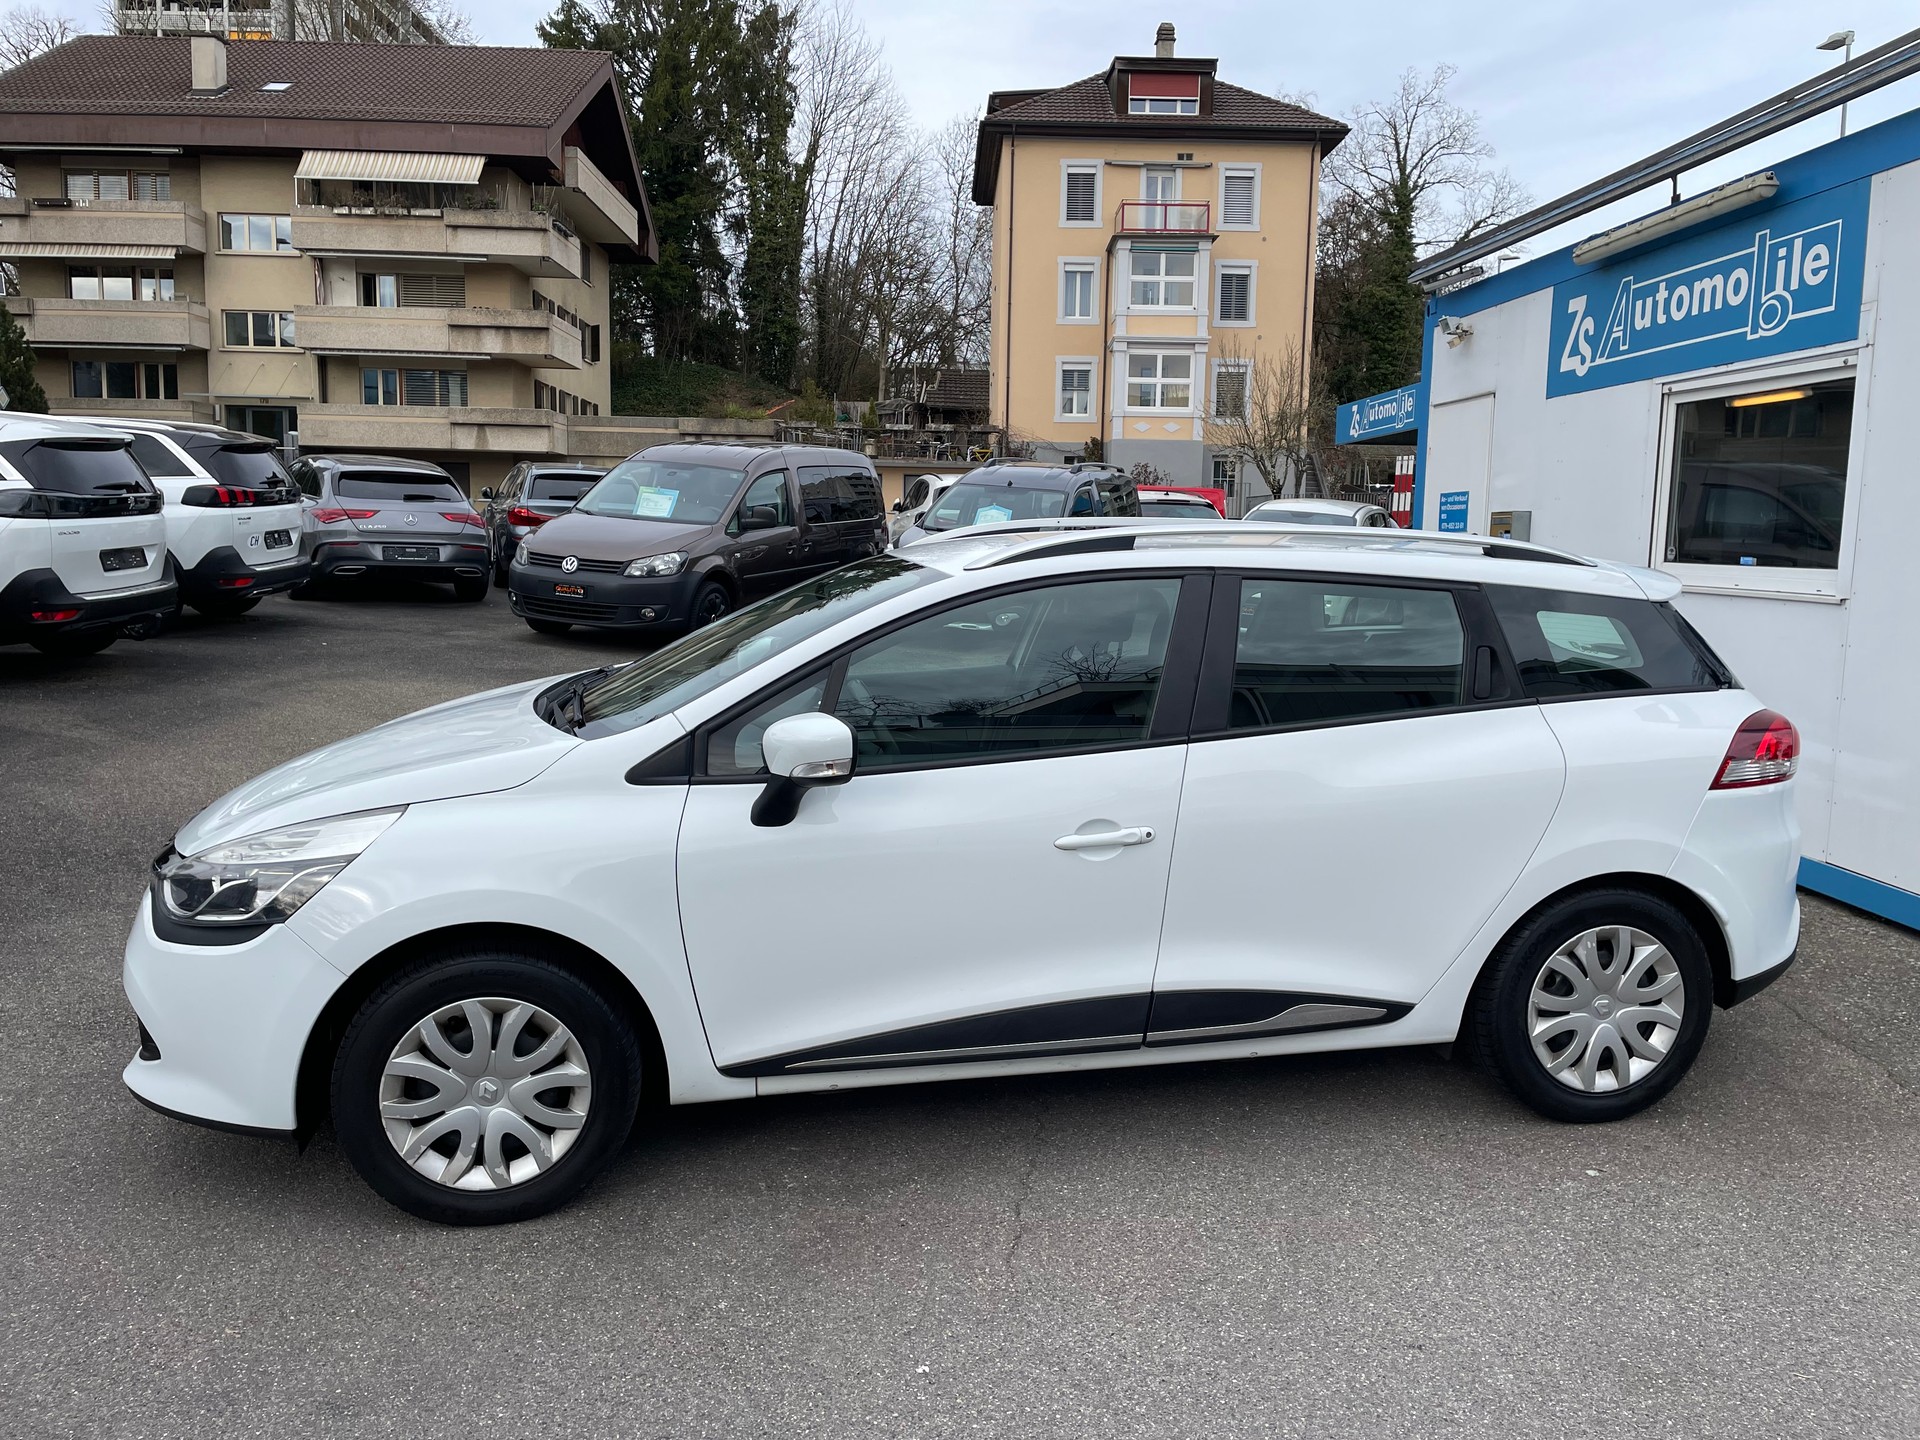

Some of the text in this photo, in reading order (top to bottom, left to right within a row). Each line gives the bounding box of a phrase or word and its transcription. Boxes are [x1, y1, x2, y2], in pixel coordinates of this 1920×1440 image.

[1595, 229, 1830, 363] Automobile
[1360, 389, 1414, 432] Automobile
[250, 535, 260, 547] CH
